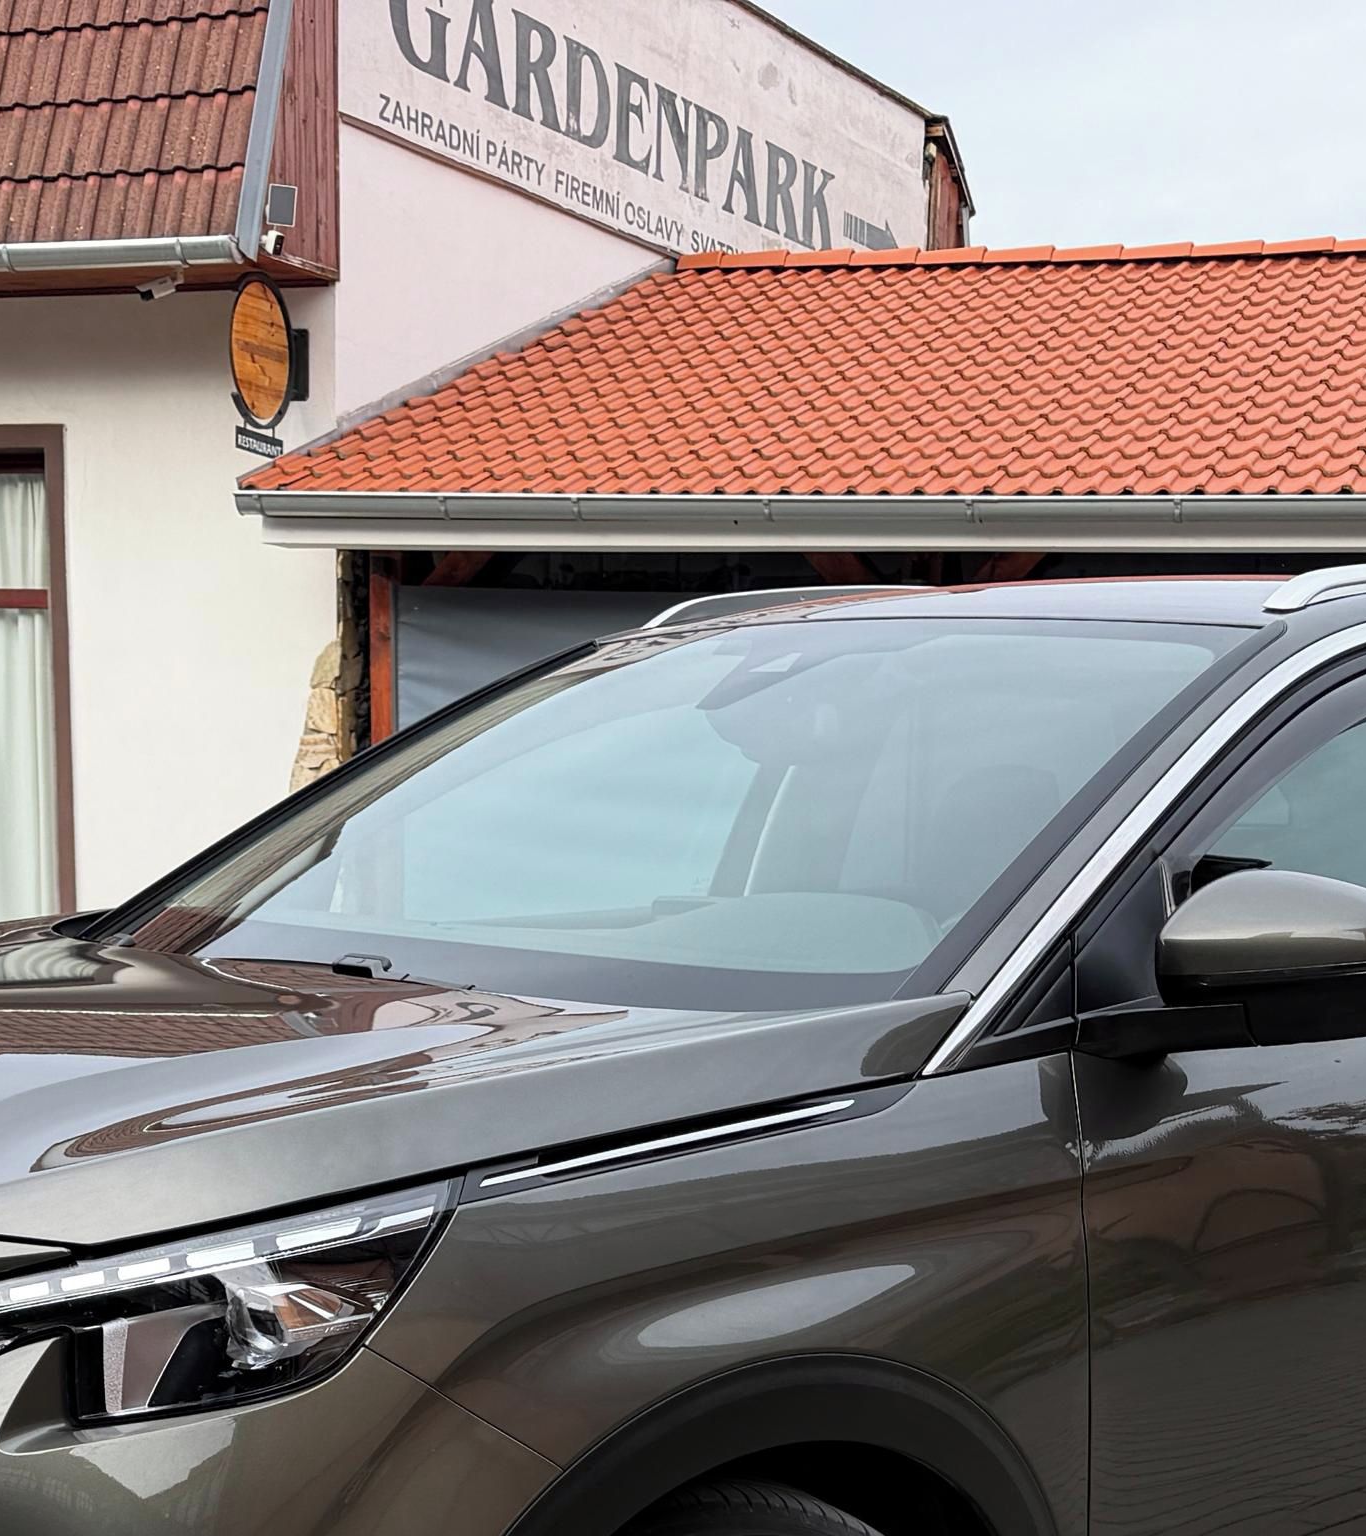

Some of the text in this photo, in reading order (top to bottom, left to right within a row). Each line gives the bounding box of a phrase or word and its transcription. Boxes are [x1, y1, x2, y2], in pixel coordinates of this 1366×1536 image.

[379, 93, 481, 161] ZAHRADNÍ
[486, 140, 546, 187] PÁRTY
[555, 169, 620, 220] FIREMNÍ
[624, 201, 684, 247] OSLAVY
[389, 0, 836, 251] GARDENPARK
[237, 433, 283, 457] RESTAURANT
